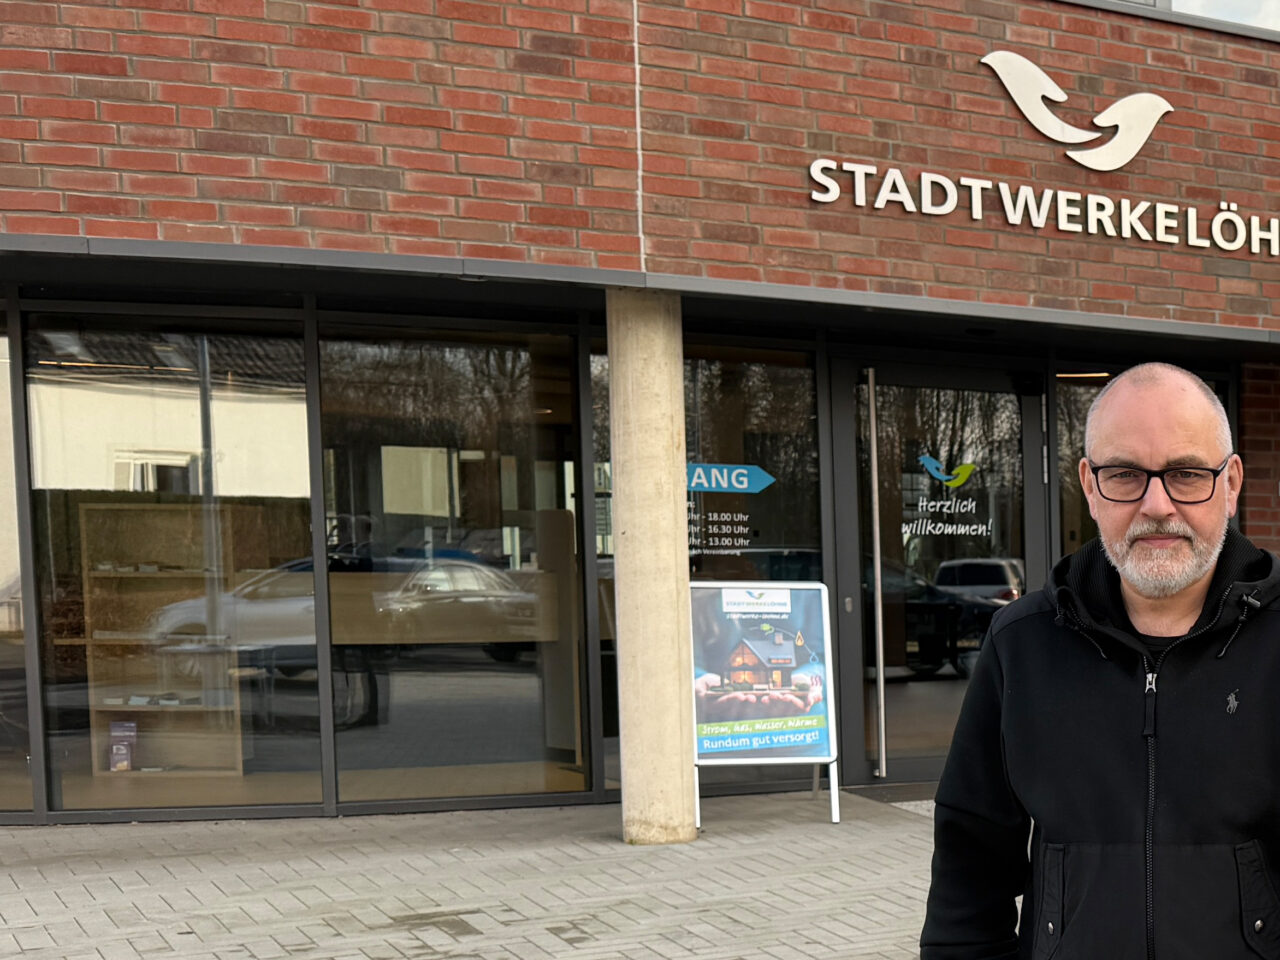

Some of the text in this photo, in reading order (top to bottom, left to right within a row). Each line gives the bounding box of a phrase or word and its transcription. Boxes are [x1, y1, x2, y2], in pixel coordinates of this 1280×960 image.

[686, 467, 749, 489] ANG
[918, 496, 976, 514] Herzlich
[708, 512, 731, 521] 18.00
[733, 512, 749, 522] Uhr
[708, 524, 731, 533] 16.30
[733, 524, 749, 534] Uhr
[901, 518, 992, 537] willkommen!
[709, 537, 732, 545] 13.00
[734, 537, 750, 546] Uhr
[704, 730, 820, 749] Rundum gut versorgt!
